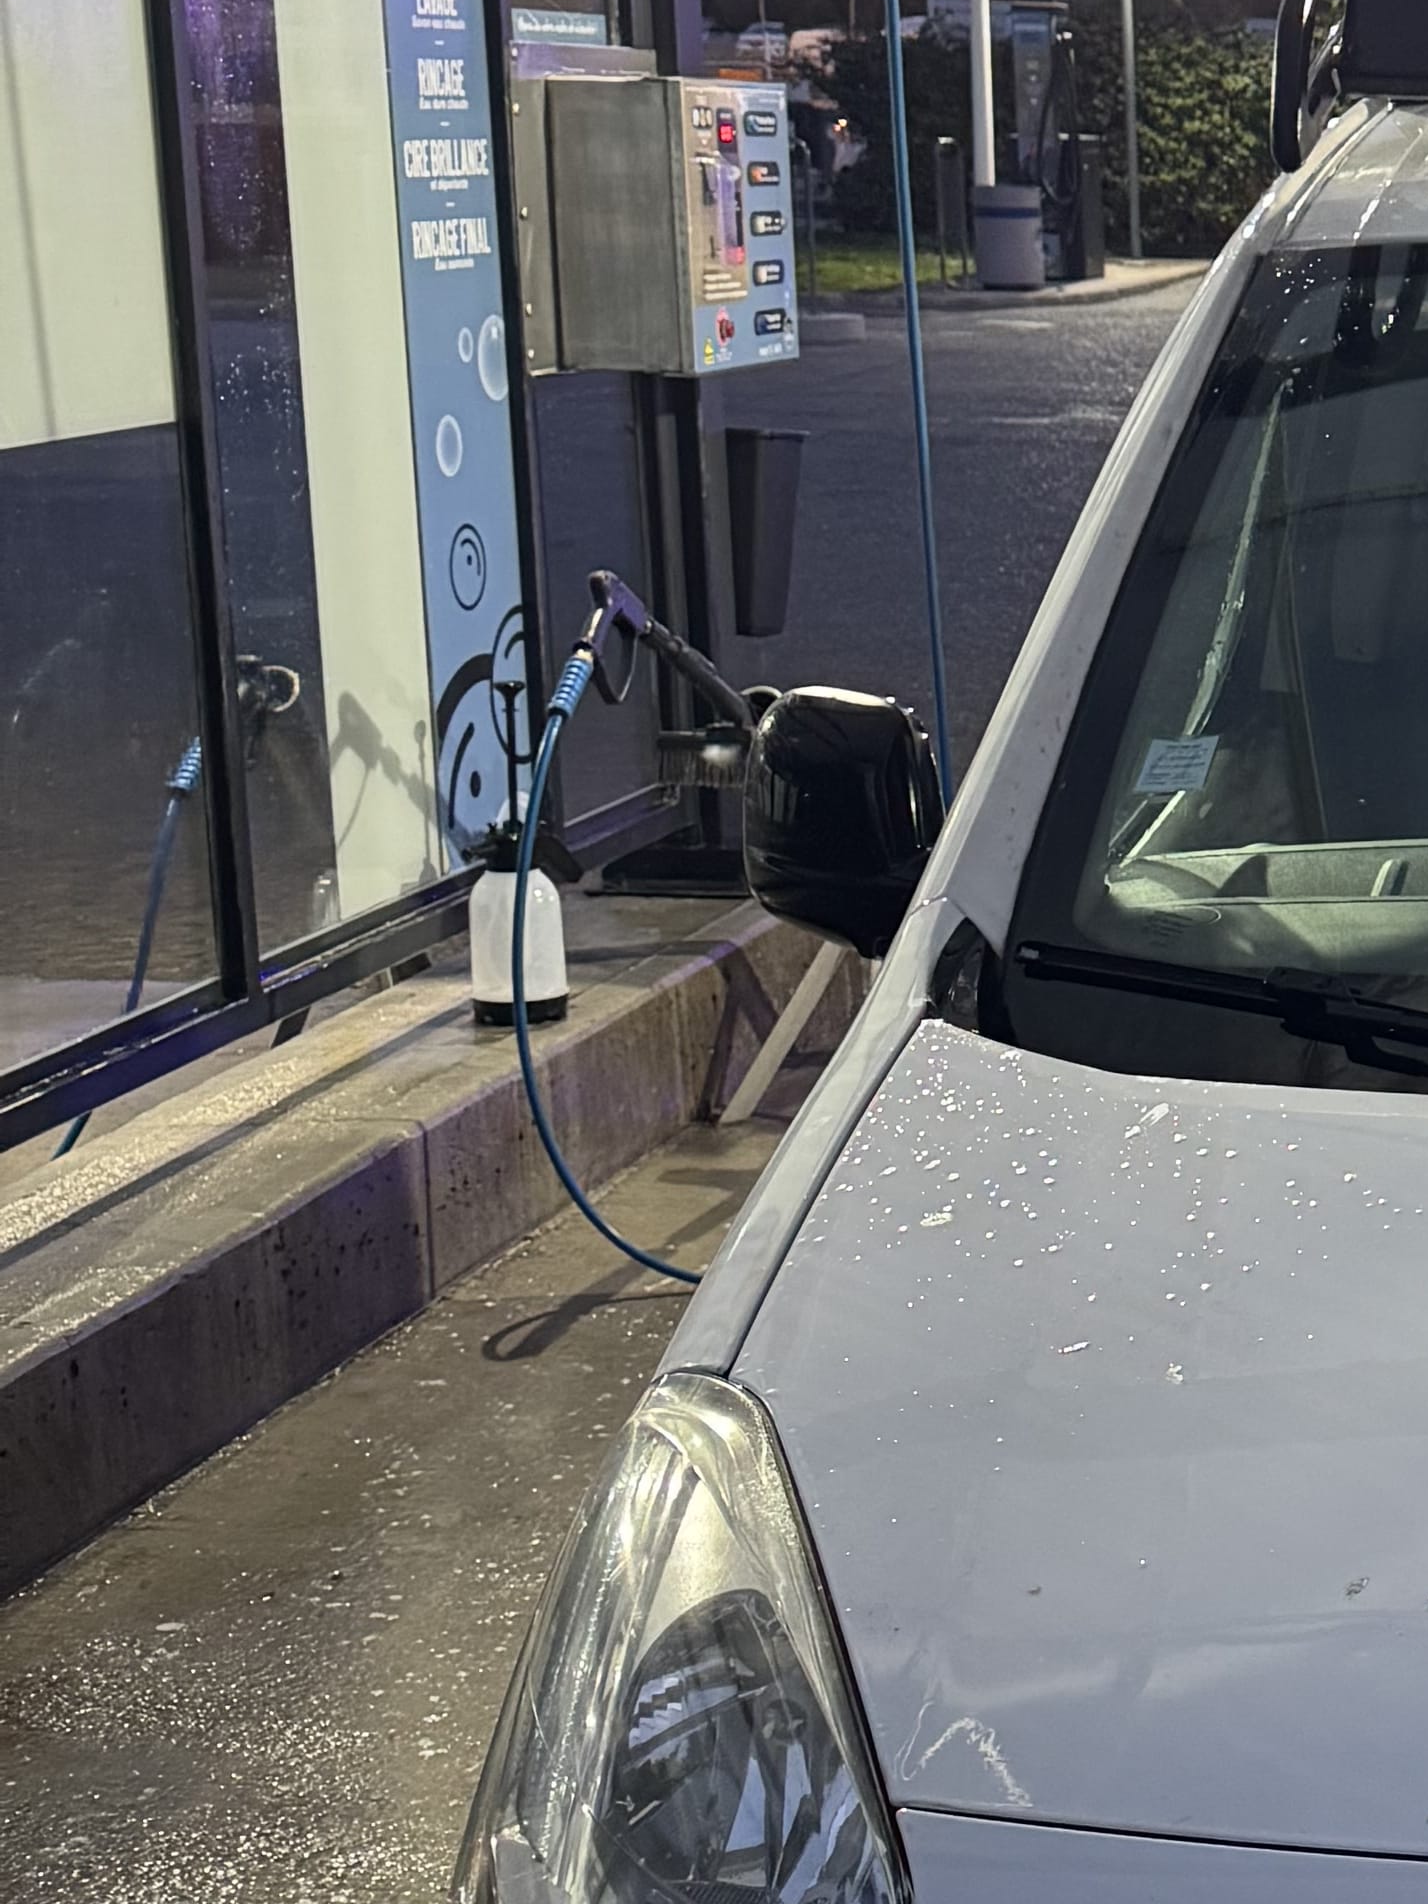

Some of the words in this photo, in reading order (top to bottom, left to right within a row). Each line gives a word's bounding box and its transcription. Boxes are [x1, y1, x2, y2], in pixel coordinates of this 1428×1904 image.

[417, 58, 466, 97] RINCAGE
[403, 140, 430, 178] CIRE
[430, 139, 489, 177] BRILLANCE
[411, 218, 460, 259] RINCAGE
[460, 217, 492, 256] FINAL
